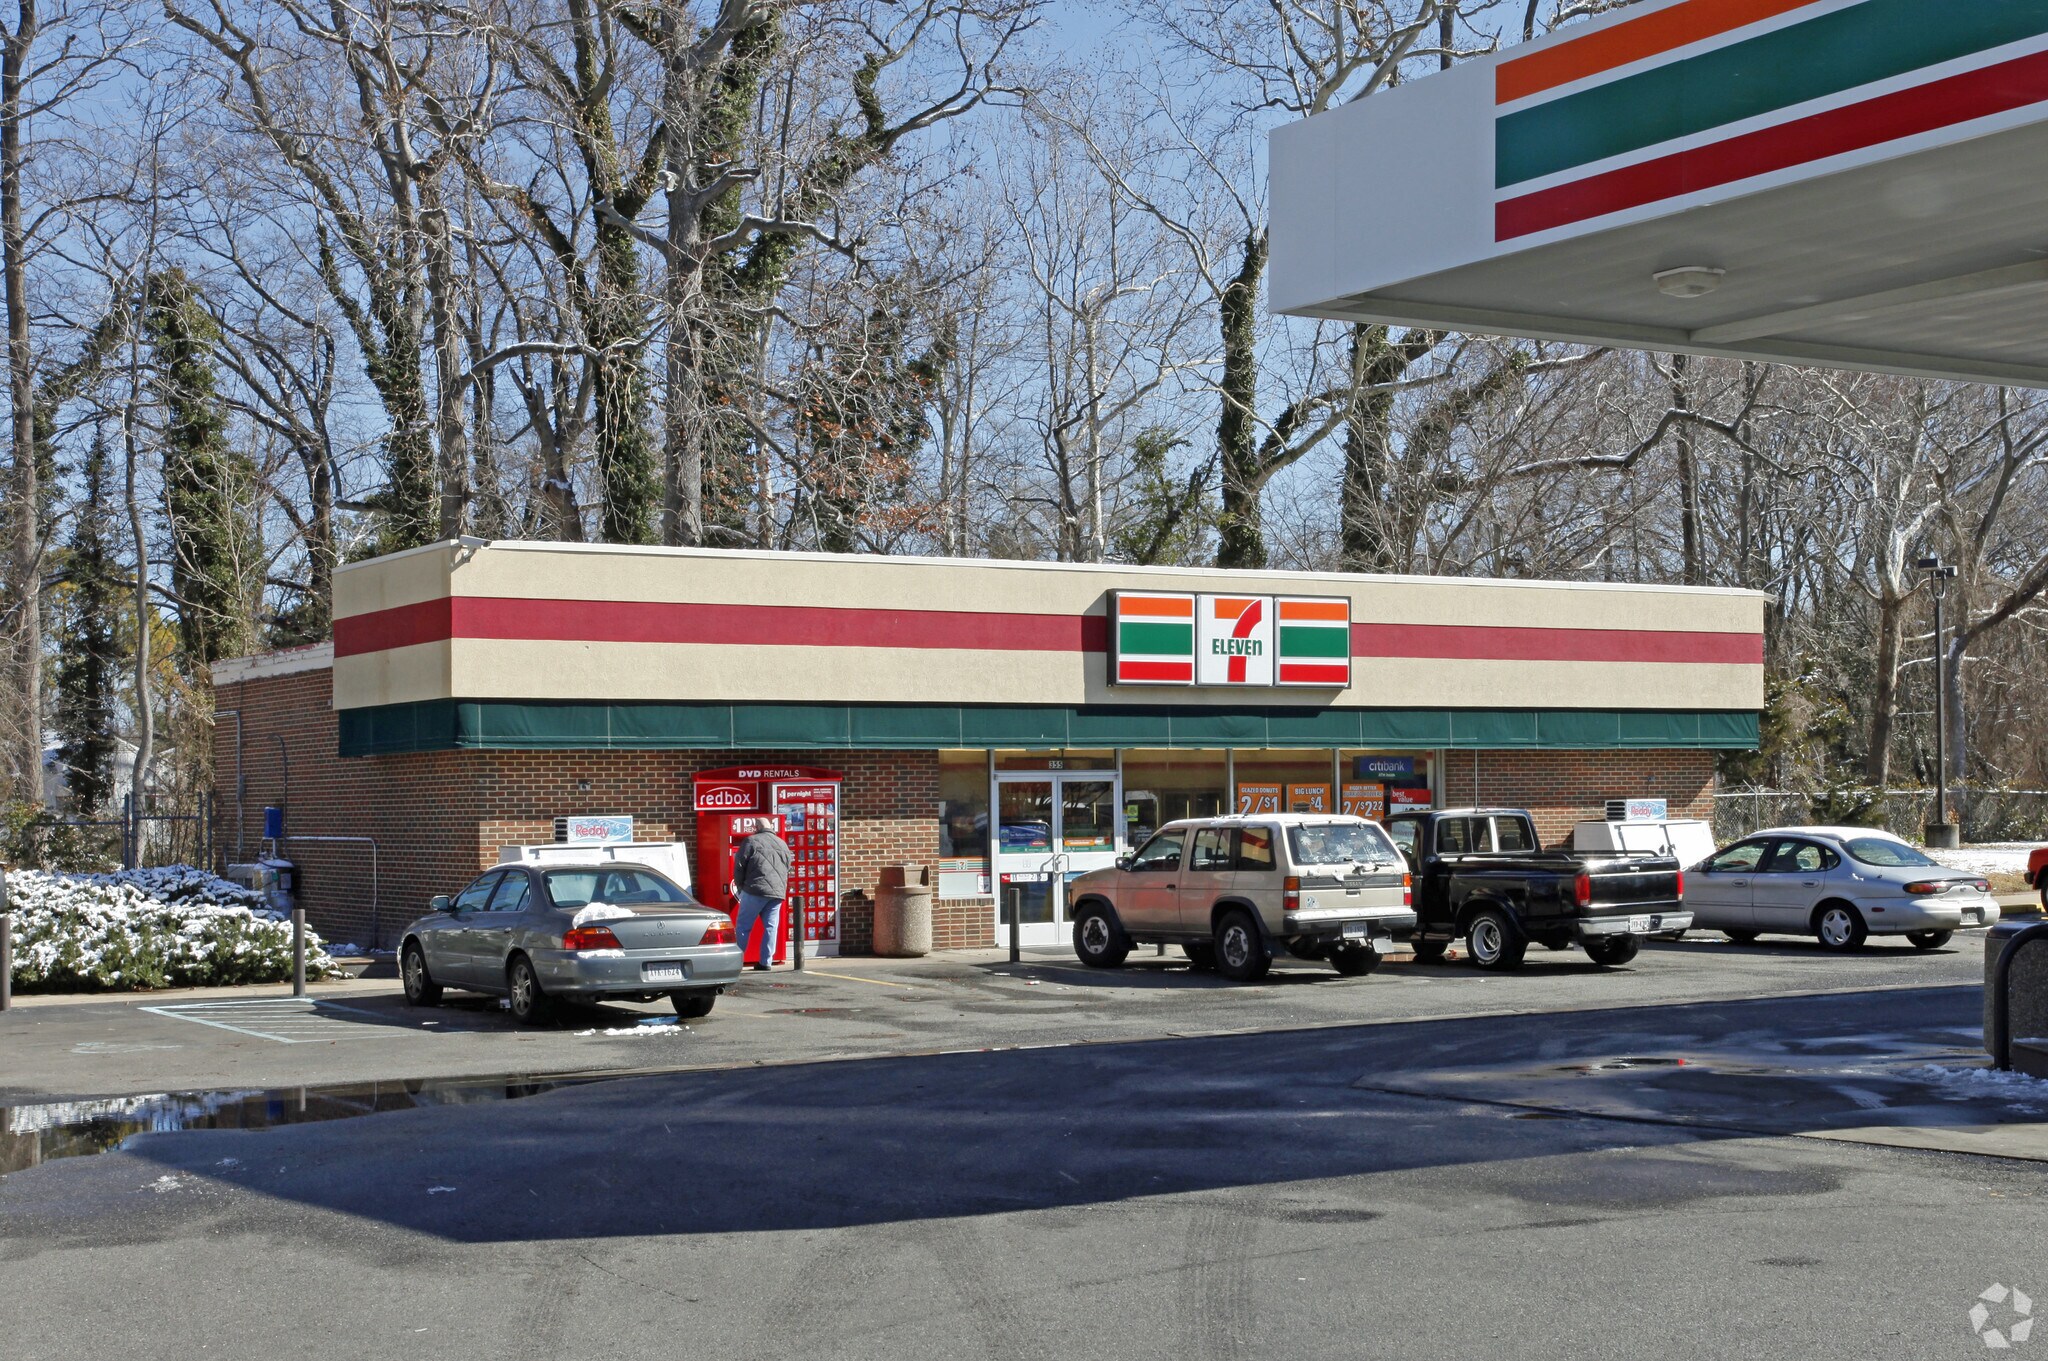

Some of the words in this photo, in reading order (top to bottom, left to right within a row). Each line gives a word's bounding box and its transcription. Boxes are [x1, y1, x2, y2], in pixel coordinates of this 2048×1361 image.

[1213, 598, 1262, 683] 7
[738, 770, 762, 778] DVD
[763, 769, 800, 778] RENTALS
[1368, 761, 1405, 771] citibank
[700, 791, 751, 806] redbox
[1392, 790, 1405, 798] best
[1311, 796, 1323, 812] $4
[575, 824, 609, 839] Reddy
